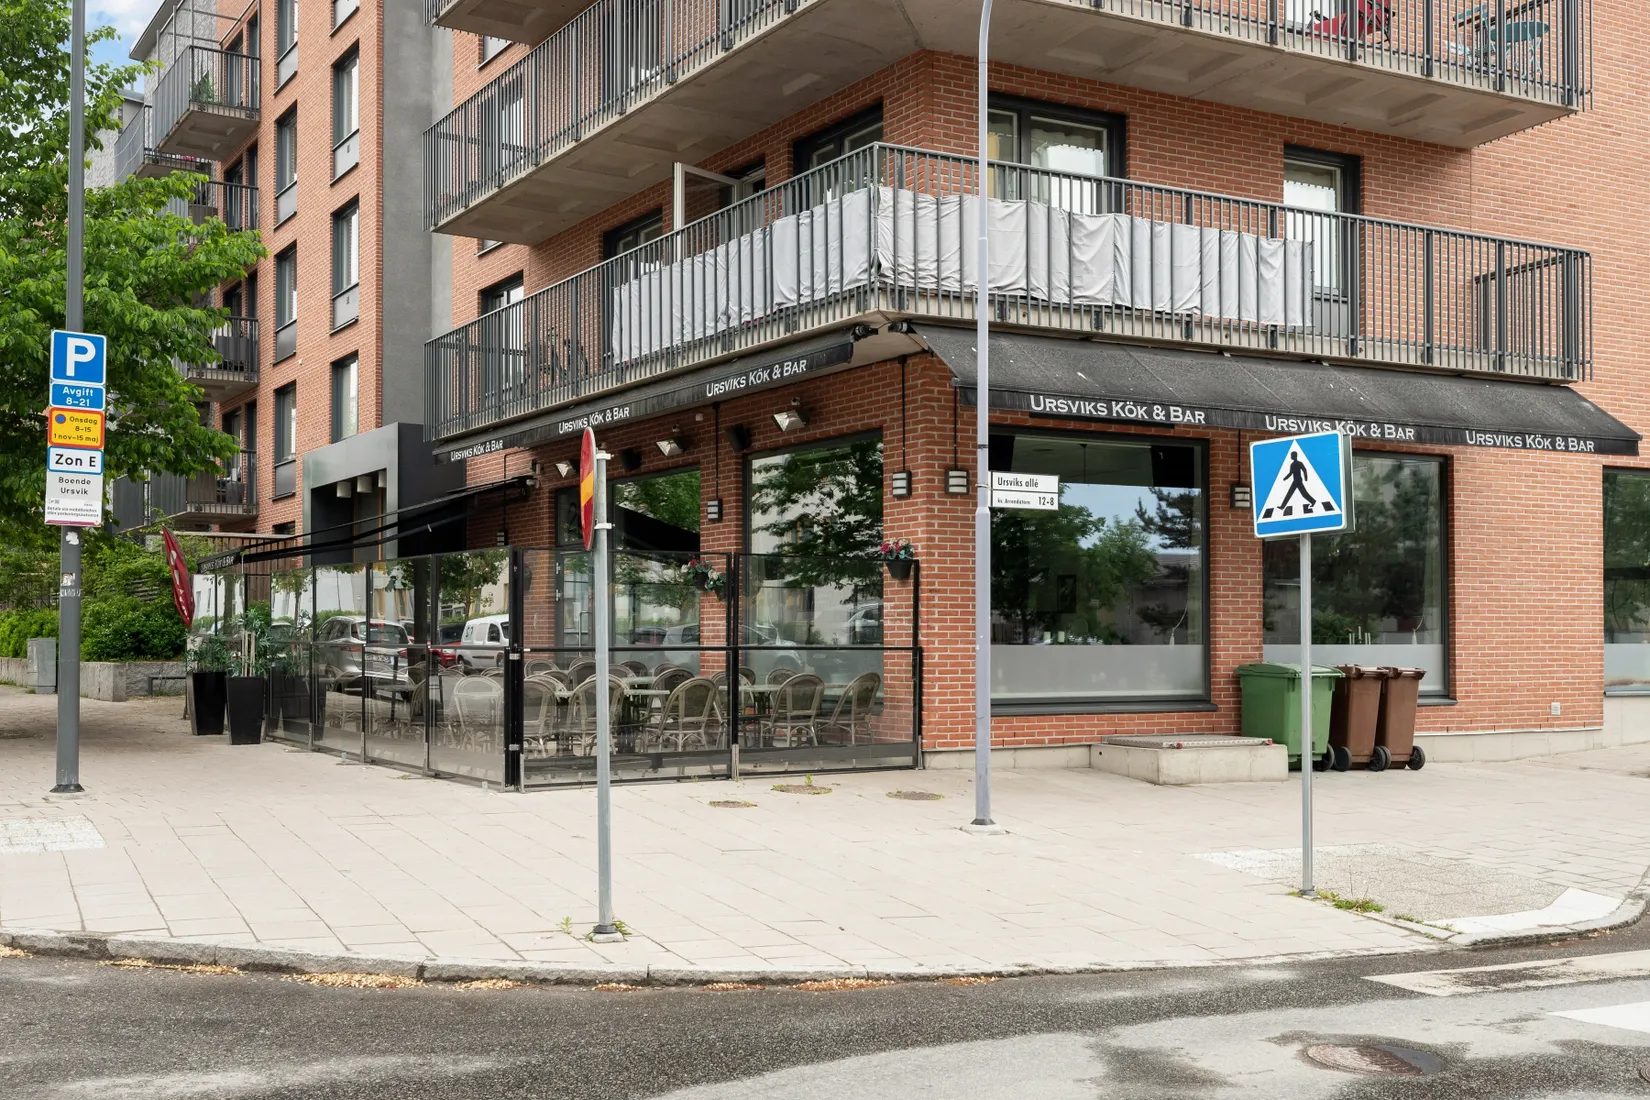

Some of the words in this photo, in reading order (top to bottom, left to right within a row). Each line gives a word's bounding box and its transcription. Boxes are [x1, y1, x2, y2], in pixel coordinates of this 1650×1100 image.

[66, 337, 96, 377] P
[772, 364, 781, 379] &
[62, 386, 94, 397] Avgift
[66, 397, 90, 407] 8-21
[605, 409, 612, 422] &
[1152, 405, 1166, 420] &
[69, 416, 98, 425] Onsdag
[1370, 423, 1381, 438] &
[1555, 437, 1566, 450] &
[55, 453, 83, 467] Zon
[89, 456, 96, 467] E
[58, 477, 91, 485] Boende
[997, 477, 1023, 487] Ursviks
[1025, 478, 1039, 488] allé
[60, 487, 89, 495] Ursvik
[1038, 497, 1054, 506] 12-8
